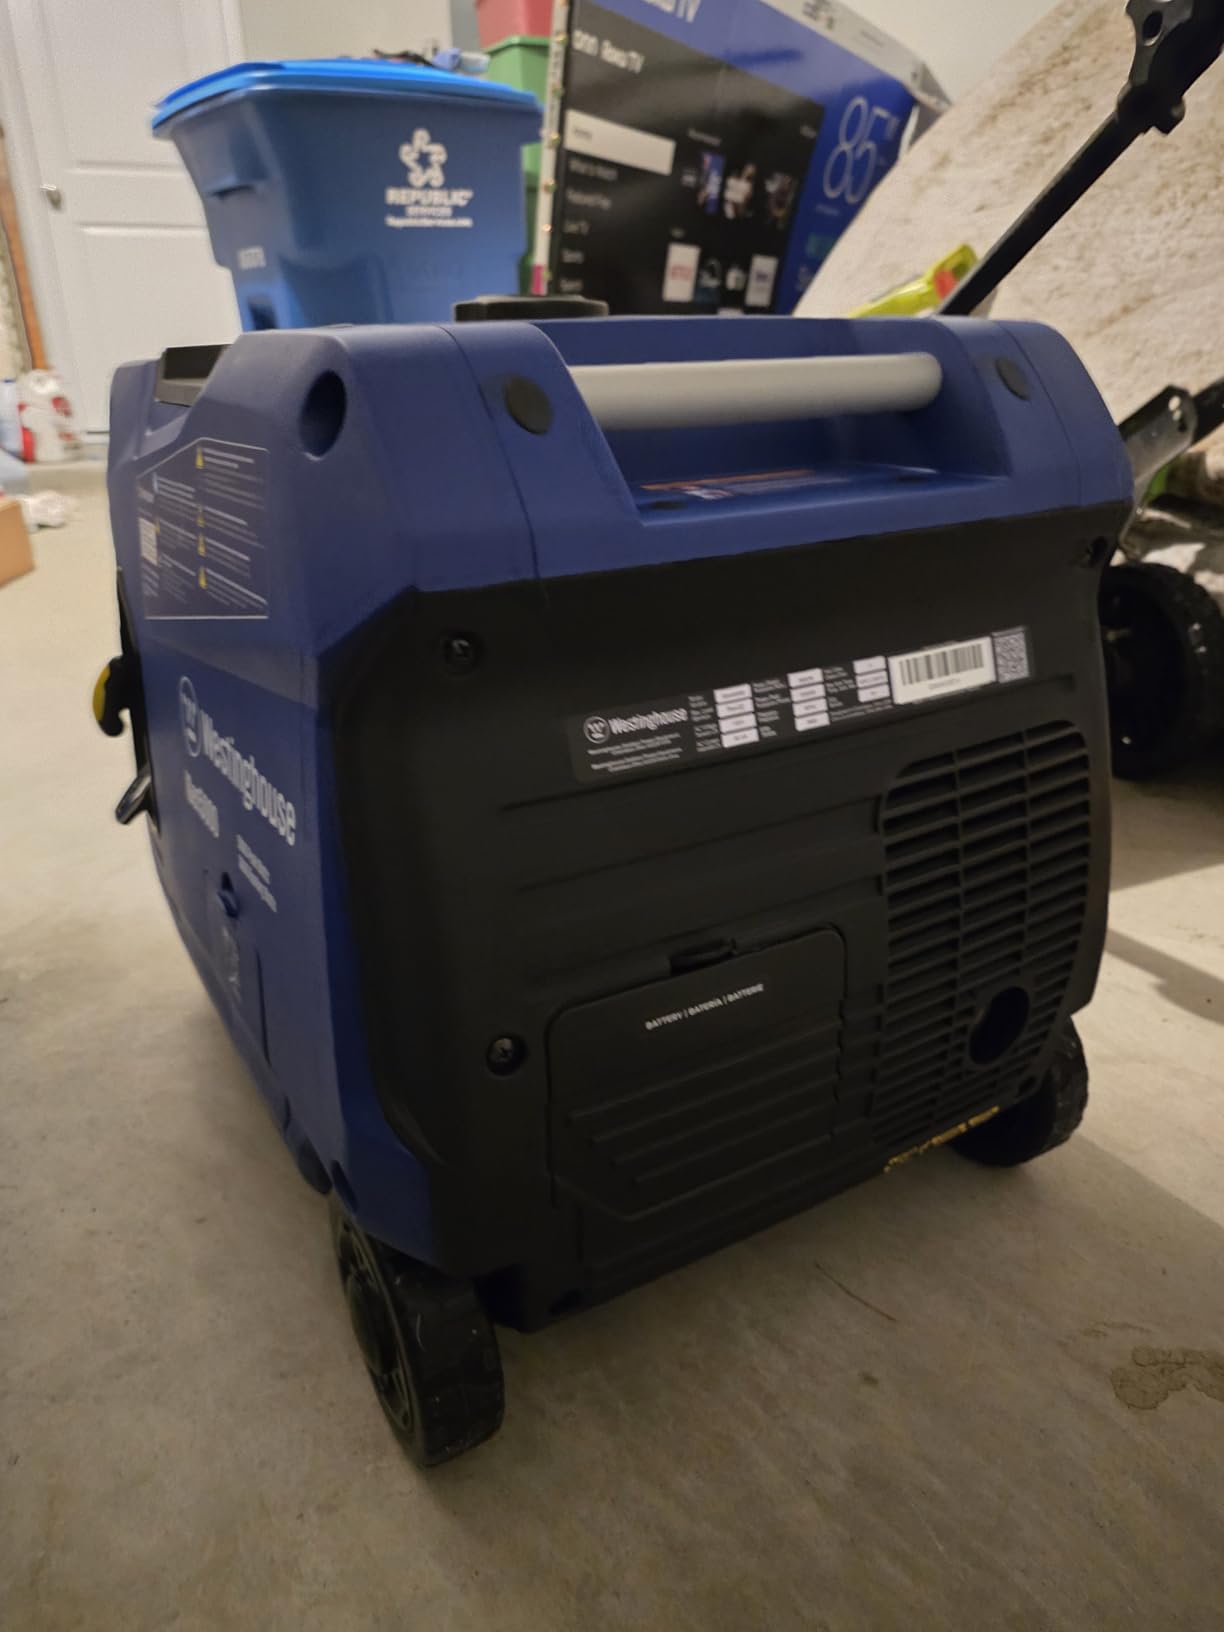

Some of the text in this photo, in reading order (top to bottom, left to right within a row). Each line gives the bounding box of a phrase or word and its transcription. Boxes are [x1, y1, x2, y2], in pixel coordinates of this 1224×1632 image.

[385, 188, 470, 206] REPUBLIC
[608, 707, 689, 735] Westinghouse
[199, 708, 297, 846] Westinghouse
[645, 1010, 682, 1030] BATTERY
[726, 983, 764, 1003] BATTERIE
